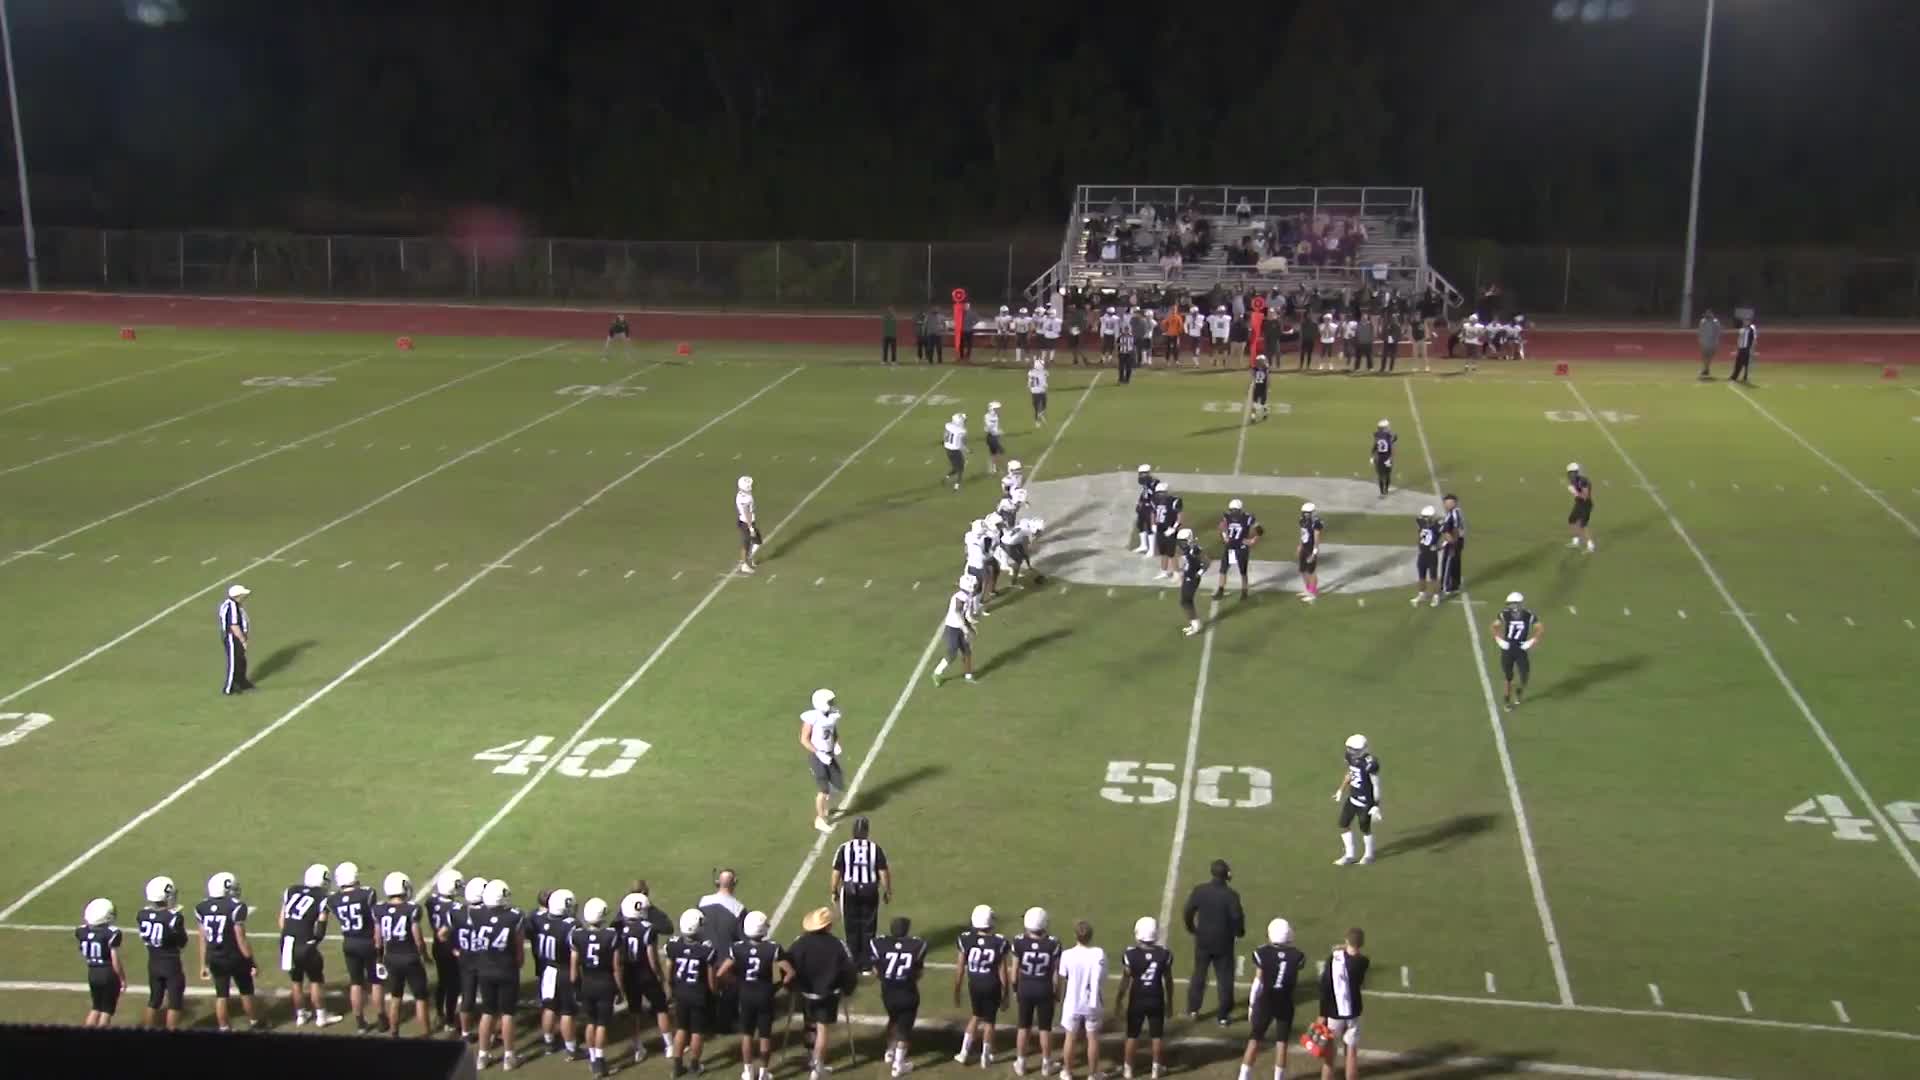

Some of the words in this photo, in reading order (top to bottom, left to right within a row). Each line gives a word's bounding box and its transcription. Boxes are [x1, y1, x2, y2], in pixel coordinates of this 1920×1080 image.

[1507, 620, 1525, 640] 17
[473, 736, 652, 778] 40
[1100, 761, 1273, 808] 50
[337, 903, 363, 931] 55
[381, 915, 408, 942] 84
[139, 920, 164, 947] 20
[477, 925, 511, 951] 64
[675, 957, 700, 983] 75
[745, 956, 761, 981] 2
[885, 951, 913, 980] 72
[1022, 951, 1051, 977] 52
[1273, 960, 1287, 989] 1
